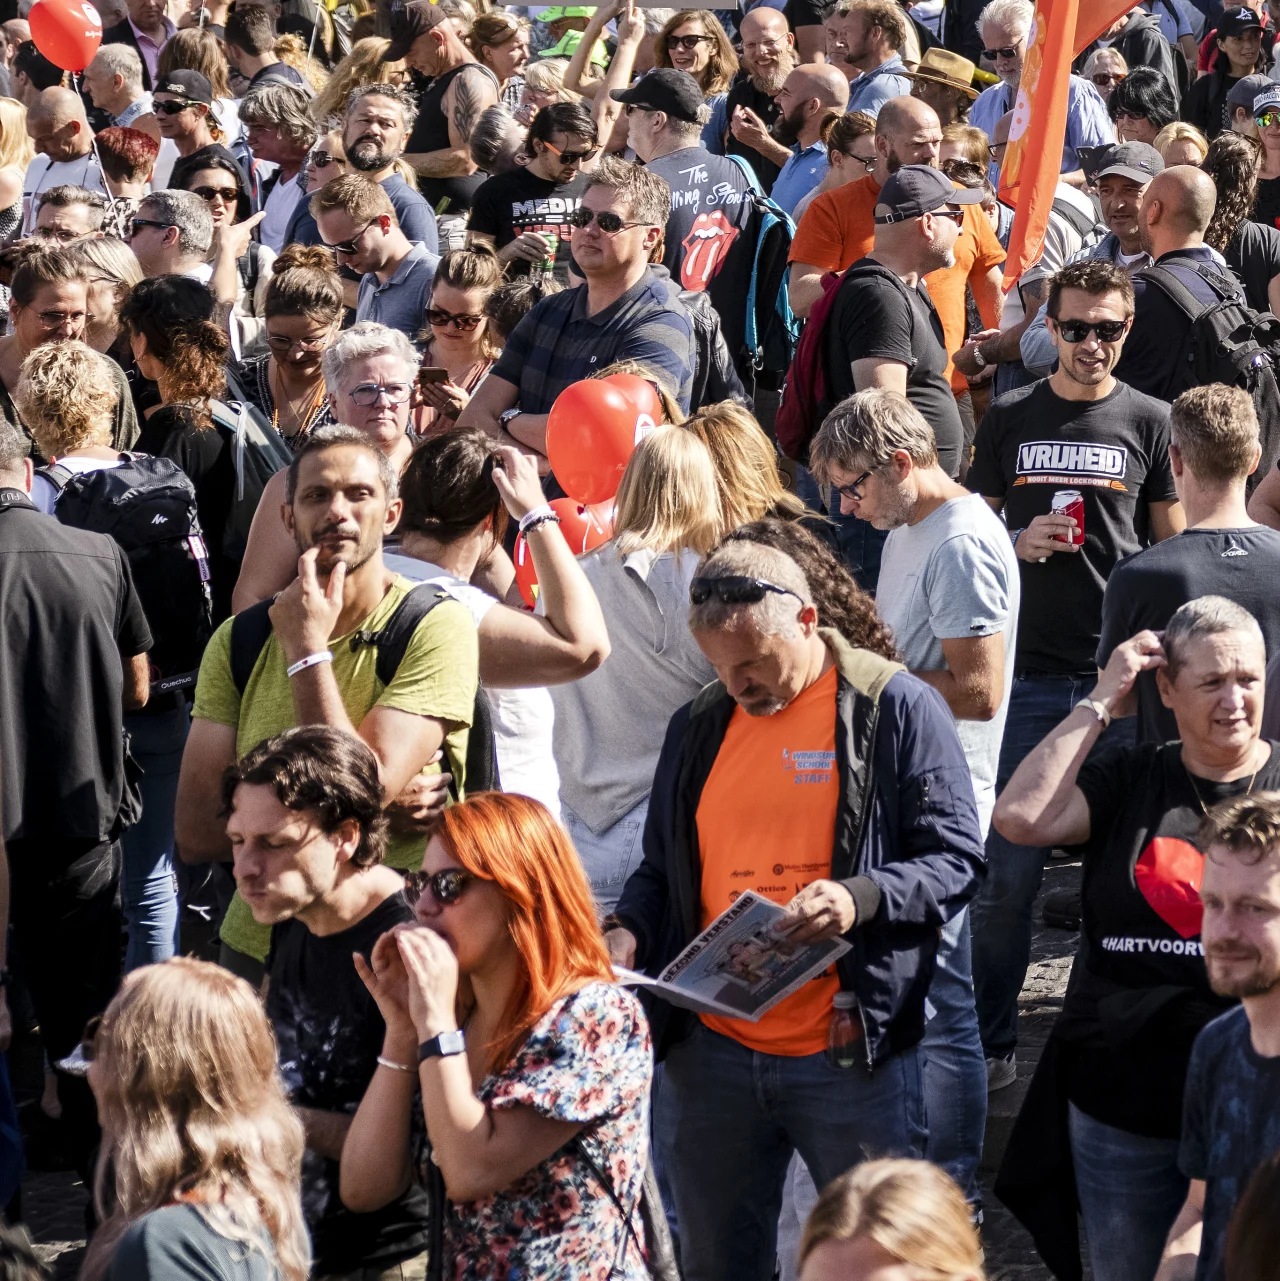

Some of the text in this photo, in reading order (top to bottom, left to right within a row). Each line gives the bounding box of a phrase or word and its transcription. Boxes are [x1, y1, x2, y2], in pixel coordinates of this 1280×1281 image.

[678, 163, 709, 186] The
[671, 189, 700, 215] lling
[1021, 444, 1122, 474] VRIJHEID
[1027, 475, 1110, 487] NOOIT MEER LOCKDOWN
[161, 676, 192, 690] Quechua
[792, 750, 836, 761] WINDSUR
[795, 760, 832, 770] SCHOOL
[794, 773, 832, 784] STAFF
[661, 895, 755, 984] GEZOND VERSTAND
[1102, 936, 1206, 957] #HARTVOORV
